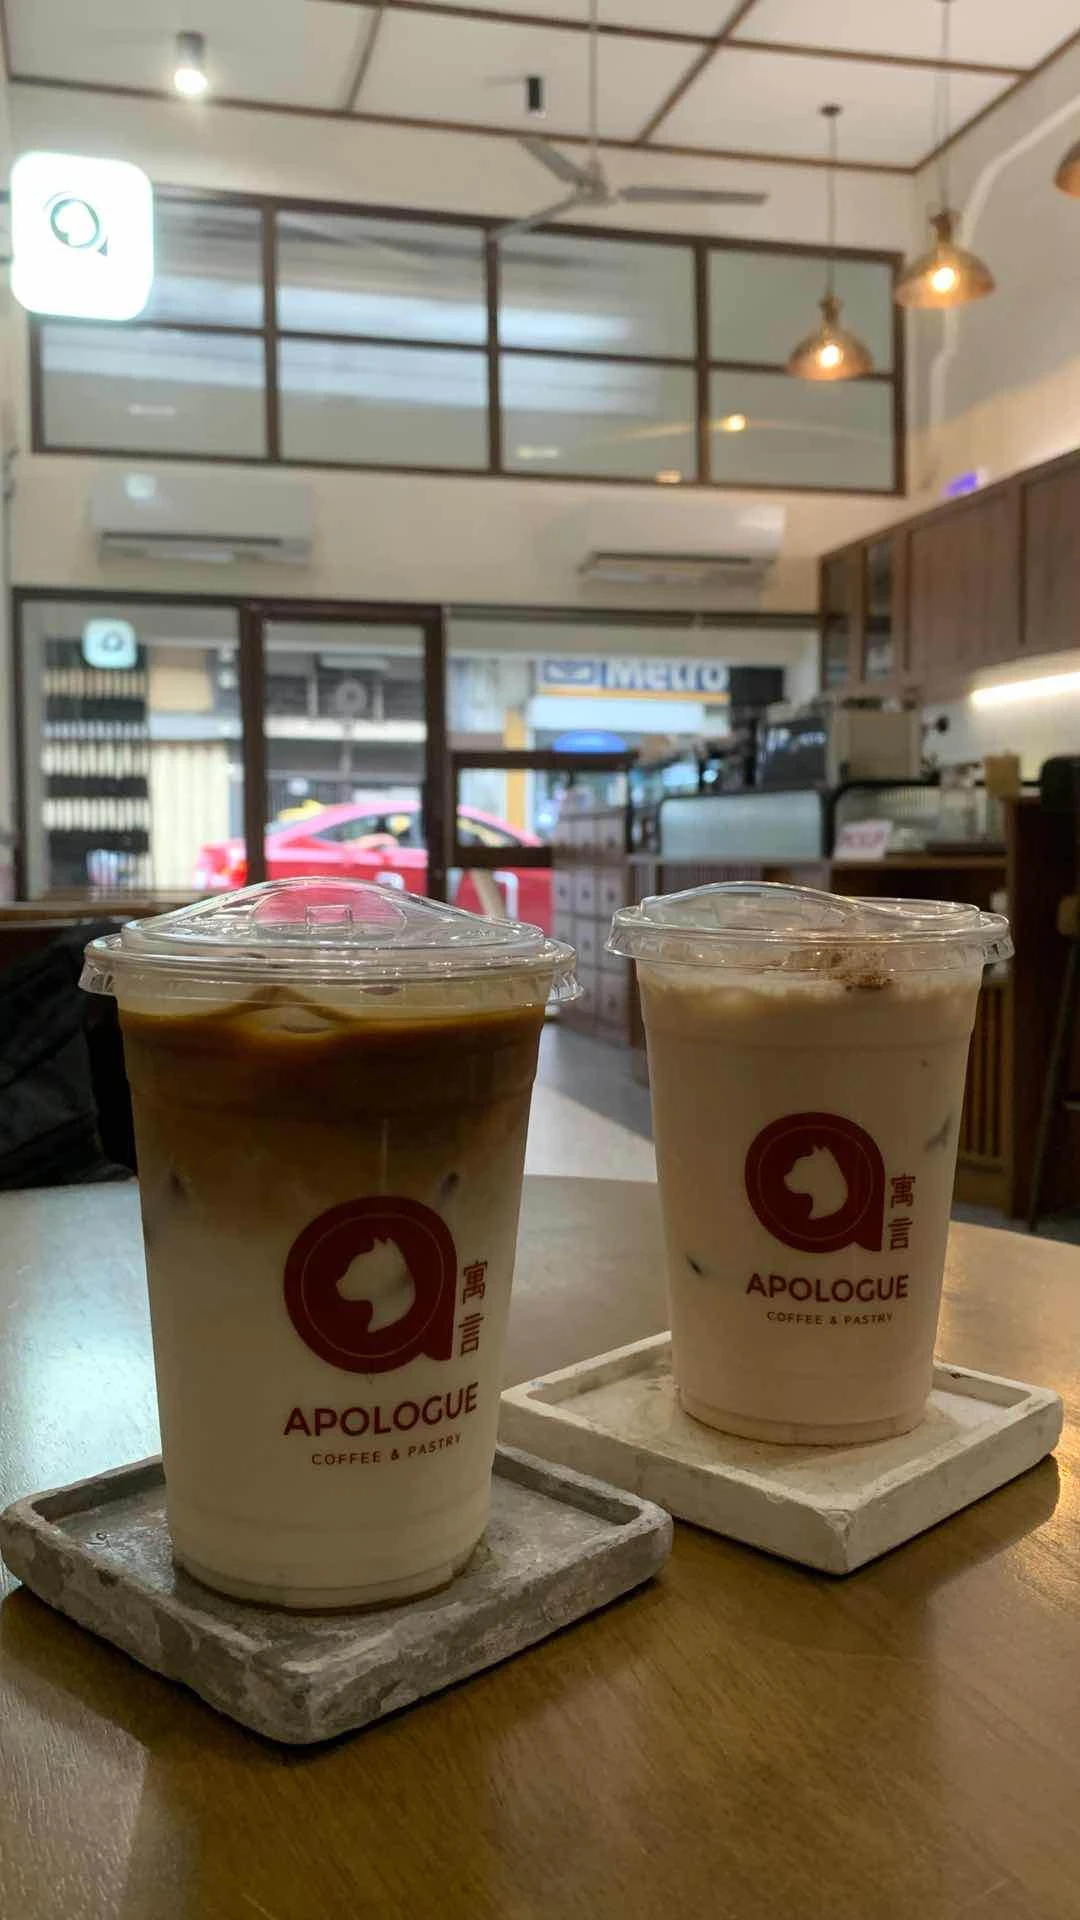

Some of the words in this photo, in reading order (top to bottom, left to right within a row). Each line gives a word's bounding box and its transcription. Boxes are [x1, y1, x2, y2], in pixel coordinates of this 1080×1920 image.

[606, 658, 729, 691] Metro
[888, 1173, 915, 1251] 寓言
[746, 1272, 909, 1303] APOLOGUE
[458, 1259, 488, 1356] 寓言
[767, 1311, 823, 1325] COFFEE
[830, 1315, 837, 1325] &
[844, 1311, 893, 1325] PASTRY
[283, 1382, 480, 1437] APOLOGUE
[311, 1451, 381, 1466] COFFEE
[391, 1449, 400, 1461] &
[407, 1433, 462, 1457] PASTRY
